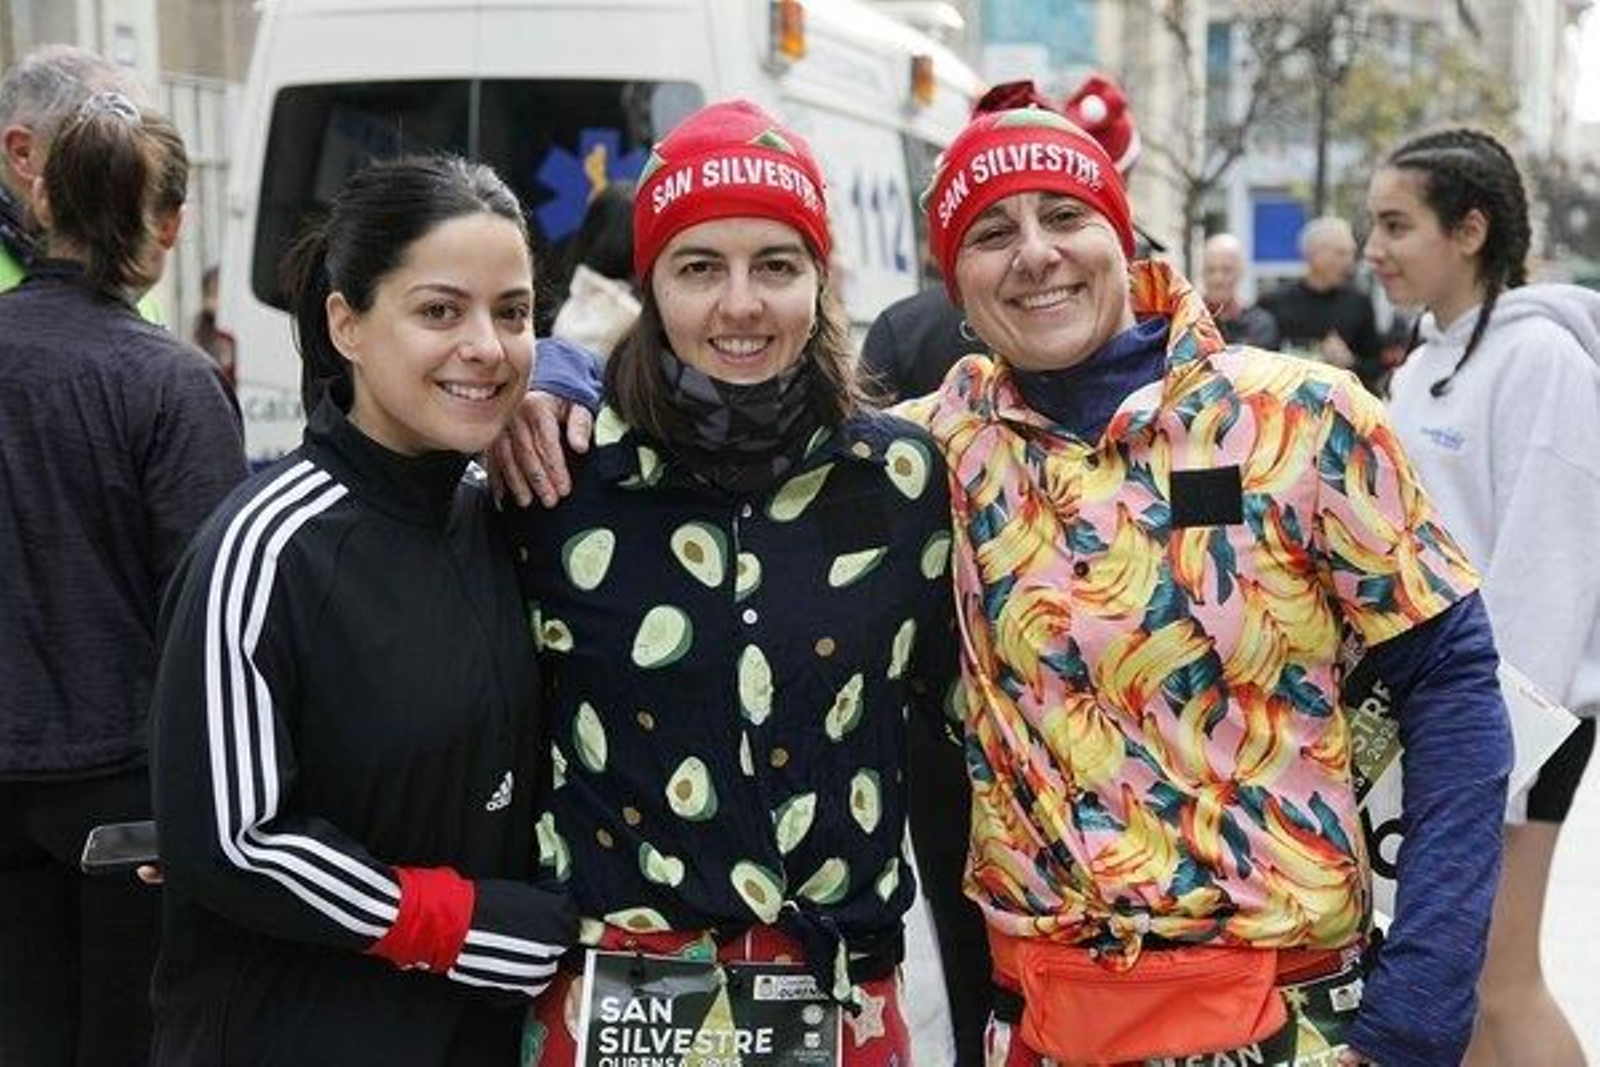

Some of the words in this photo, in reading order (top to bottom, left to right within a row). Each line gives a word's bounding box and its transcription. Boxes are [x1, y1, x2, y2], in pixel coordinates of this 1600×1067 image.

[652, 167, 693, 214] SAN
[937, 170, 970, 229] SAN
[600, 996, 673, 1024] SAN
[599, 1026, 774, 1054] SILVESTRE
